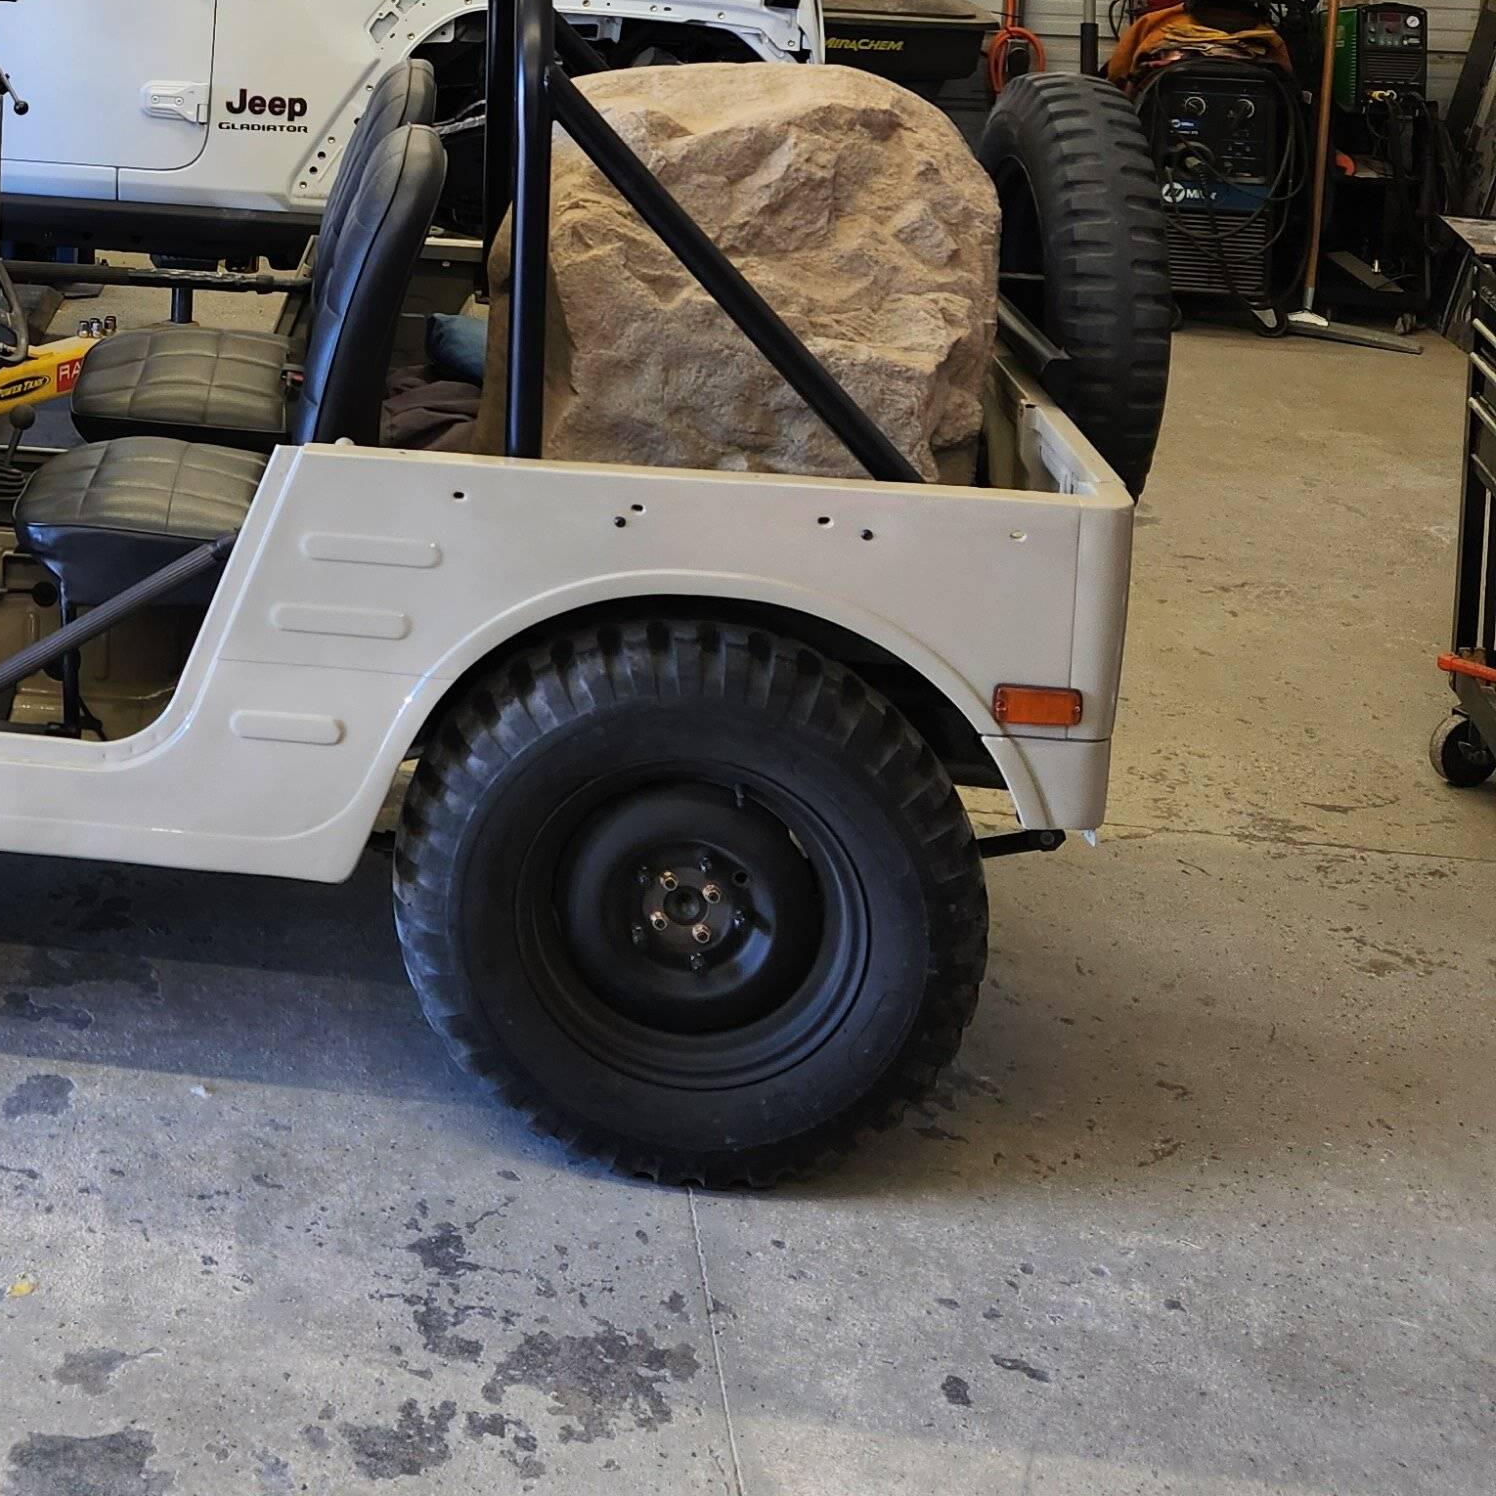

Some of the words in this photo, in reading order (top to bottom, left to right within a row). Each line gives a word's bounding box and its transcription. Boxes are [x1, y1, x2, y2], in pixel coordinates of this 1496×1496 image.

[225, 88, 308, 122] Jeep
[217, 121, 309, 134] GLADIATOR
[1186, 189, 1217, 201] Milr
